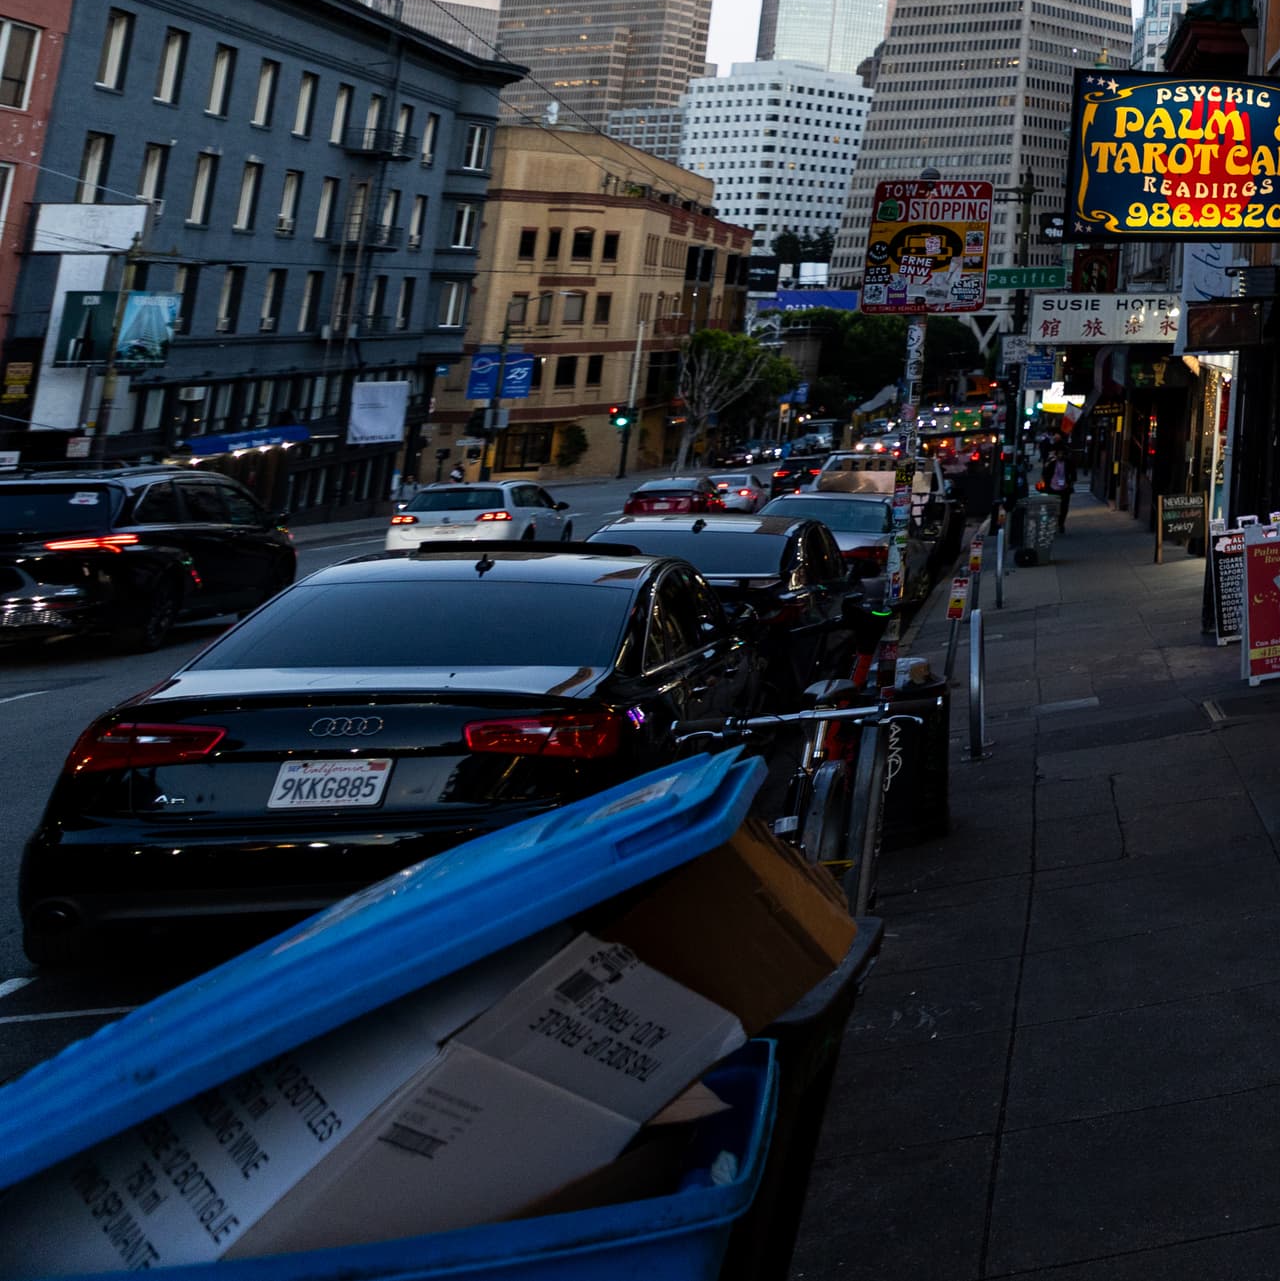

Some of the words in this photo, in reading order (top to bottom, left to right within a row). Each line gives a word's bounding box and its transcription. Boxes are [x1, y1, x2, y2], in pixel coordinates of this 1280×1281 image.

[1156, 86, 1271, 108] PSYCHIC
[1114, 107, 1246, 141] PALM
[1091, 142, 1220, 175] TAROT
[885, 184, 983, 198] TOW-AWAY
[1143, 175, 1273, 199] READINGS
[911, 201, 988, 221] STOPPING
[987, 272, 1057, 284] Pacific
[1042, 299, 1100, 311] SUSIE
[1253, 547, 1278, 557] Palm
[303, 764, 366, 776] California
[277, 776, 379, 801] 9KKG885
[287, 1076, 343, 1143] BOTTLES
[174, 1161, 240, 1245] BOTTIGLIE
